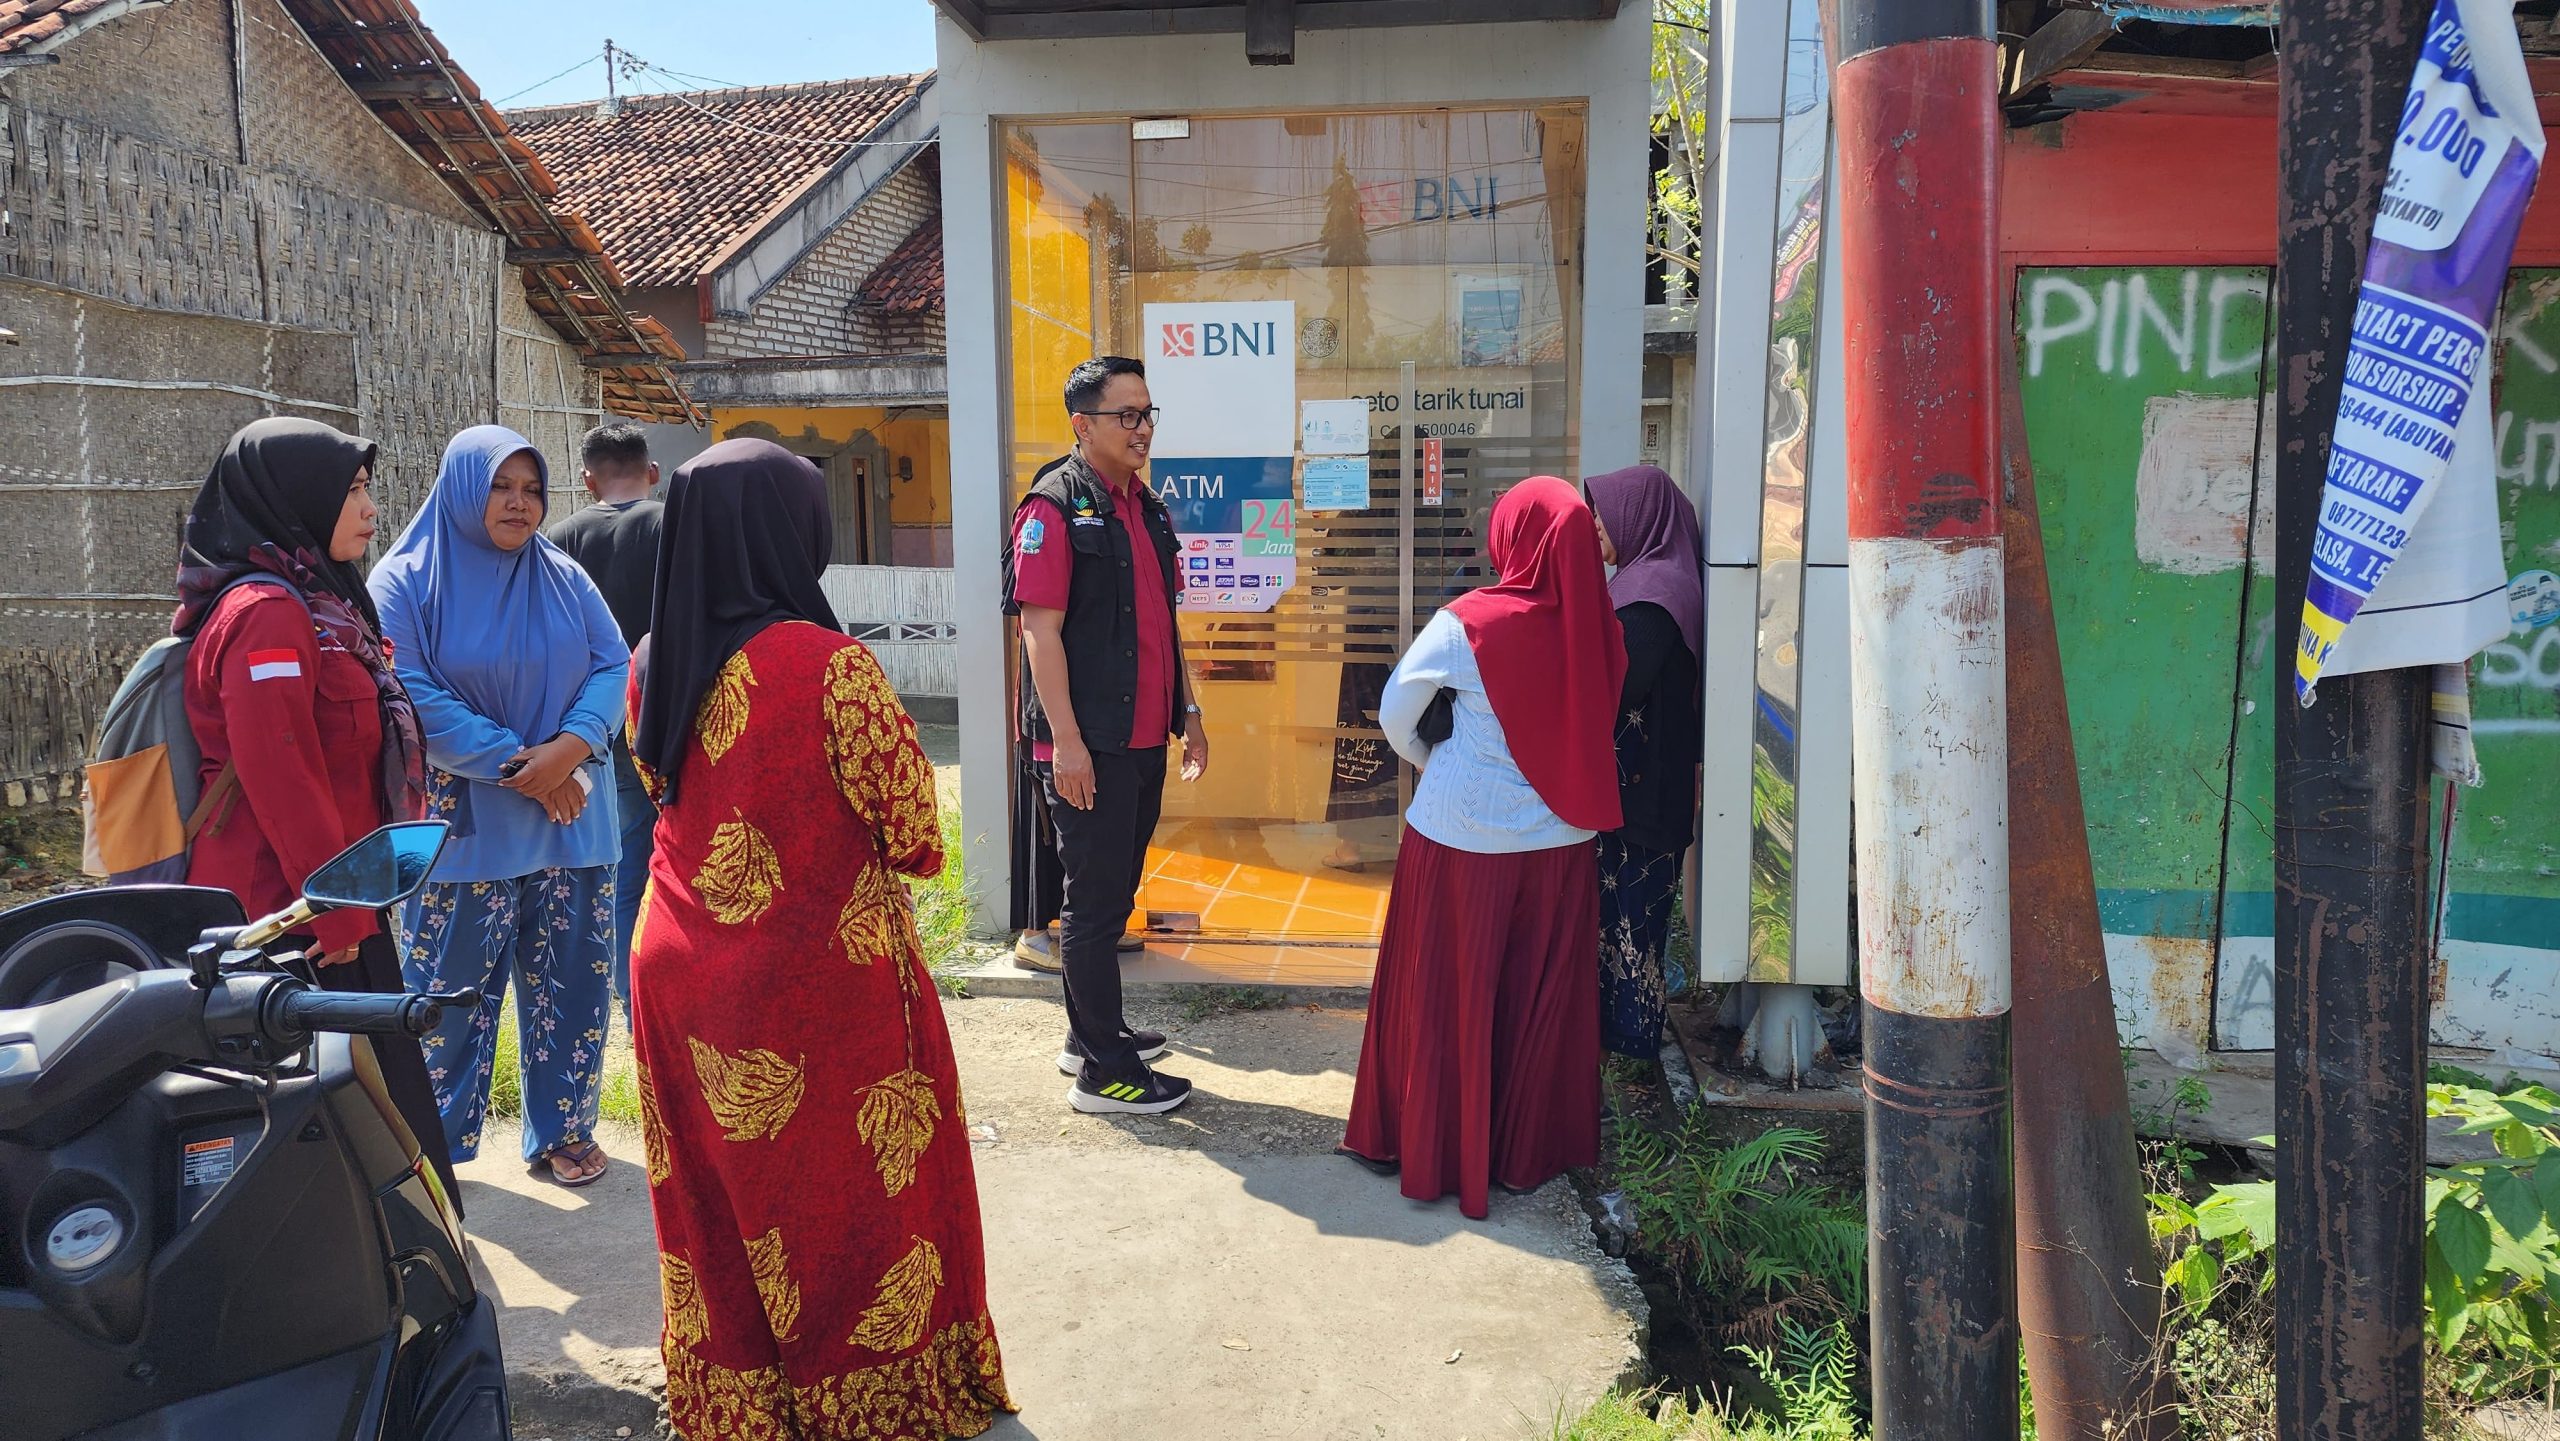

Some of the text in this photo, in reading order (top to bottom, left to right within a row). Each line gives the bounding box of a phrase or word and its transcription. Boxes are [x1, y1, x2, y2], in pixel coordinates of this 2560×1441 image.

[1413, 176, 1498, 221] BNI
[1203, 322, 1275, 357] BNI
[2417, 325, 2482, 383] PERS
[1415, 388, 1465, 410] tarik
[1468, 387, 1524, 410] tunai
[1160, 475, 1224, 498] ATM
[1245, 501, 1294, 538] 24
[2328, 501, 2411, 550] 08777123
[1260, 540, 1293, 554] Jam
